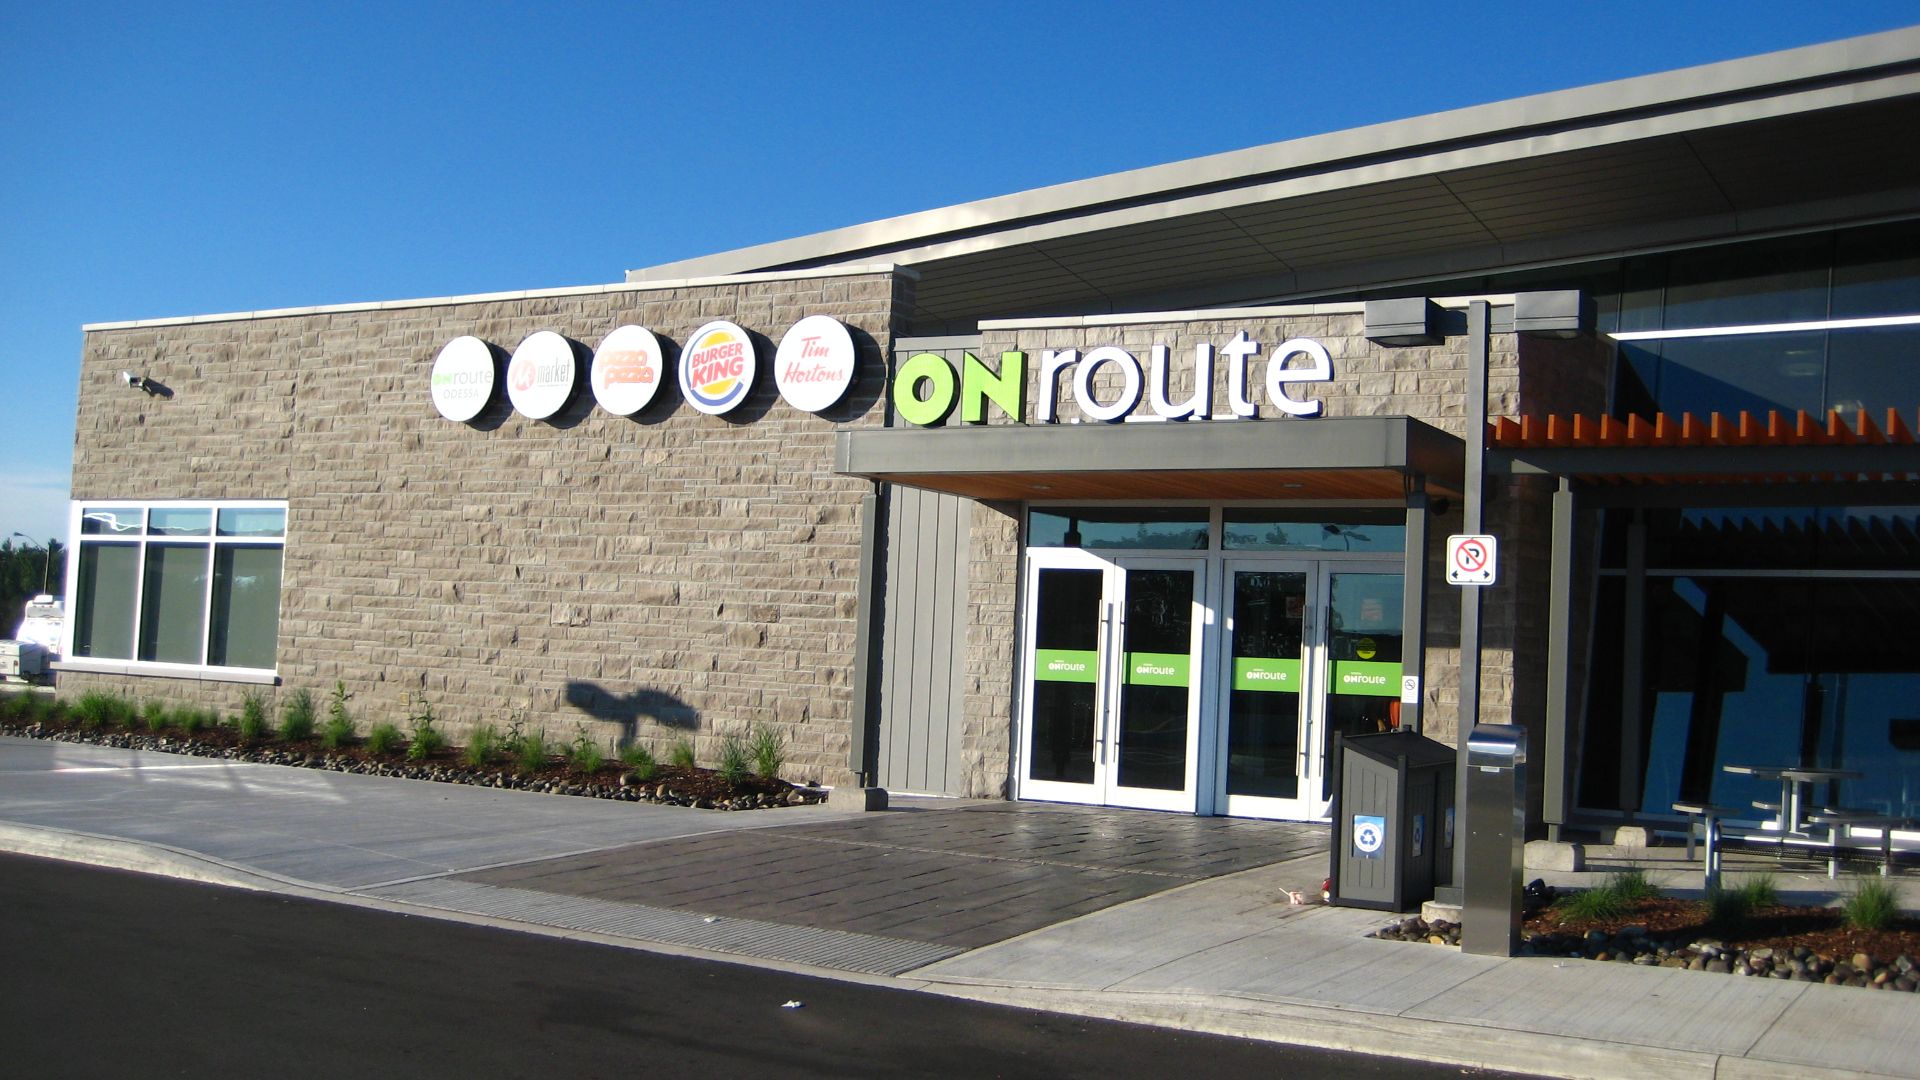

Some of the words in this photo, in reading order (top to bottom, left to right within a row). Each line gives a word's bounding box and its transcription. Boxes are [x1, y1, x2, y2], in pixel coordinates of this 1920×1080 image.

[692, 342, 744, 369] BURGER
[801, 336, 830, 358] Tim
[536, 357, 571, 384] market
[691, 357, 744, 389] KING
[783, 361, 844, 384] Hortons
[443, 388, 479, 400] ODESSA
